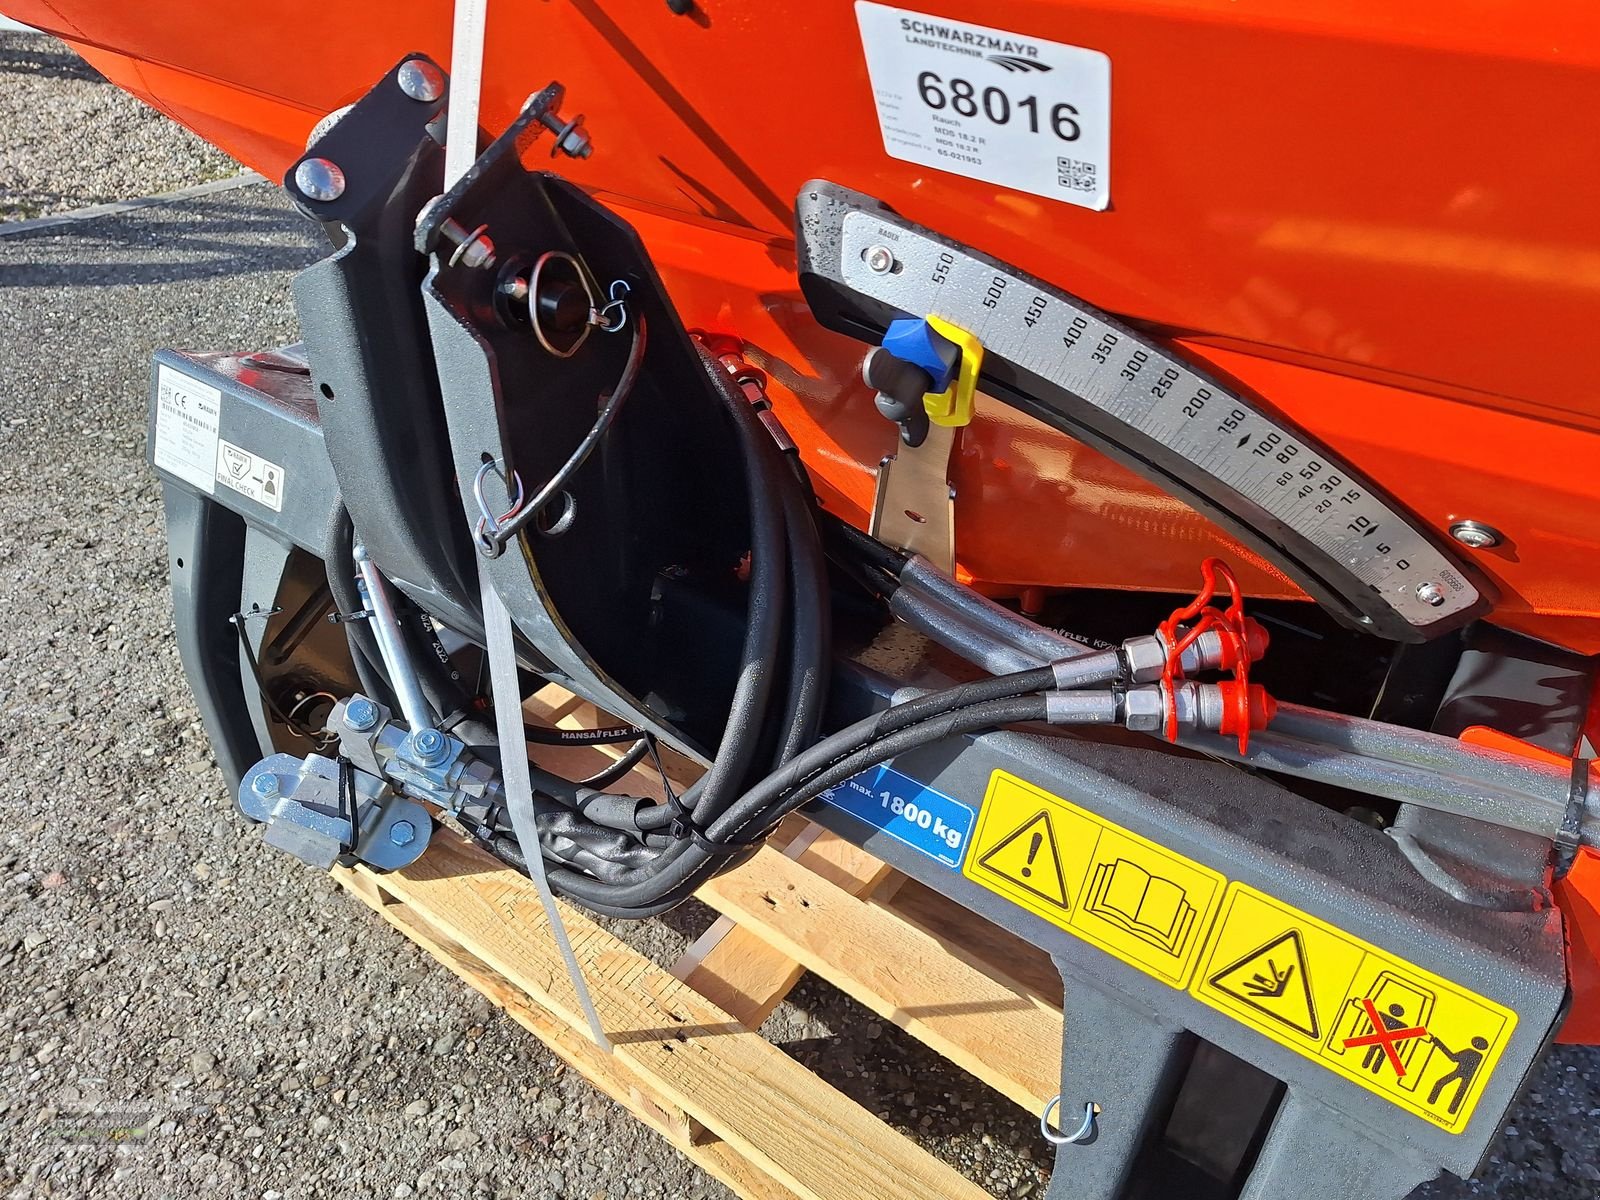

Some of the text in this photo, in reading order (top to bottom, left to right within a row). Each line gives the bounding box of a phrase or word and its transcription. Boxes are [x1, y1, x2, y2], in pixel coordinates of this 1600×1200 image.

[900, 18, 1039, 59] SCHWARZMAYR
[905, 35, 983, 58] LANDTECHNIK
[917, 71, 1080, 142] 68016
[932, 114, 961, 127] Rauch
[934, 126, 986, 145] MDS 18.2 R
[936, 137, 954, 148] MDS
[938, 147, 982, 165] 65-021953
[932, 252, 954, 285] 550
[982, 276, 1007, 309] 500
[1024, 296, 1048, 329] 450
[1062, 316, 1088, 349] 400
[1091, 332, 1118, 364] 350
[1120, 350, 1149, 382] 300
[1151, 368, 1180, 399] 250
[1182, 387, 1212, 419] 200
[1217, 409, 1246, 434] 150
[1252, 432, 1282, 458] 100
[1276, 444, 1299, 465] 80
[1276, 471, 1294, 486] 60
[1299, 460, 1322, 480] 50
[217, 472, 255, 498] FINAL CHECK
[1297, 485, 1314, 500] 40
[1320, 475, 1342, 494] 30
[1315, 498, 1332, 514] 20
[1340, 489, 1361, 505] 15
[1347, 515, 1370, 533] 10
[1376, 543, 1391, 555] 5
[1396, 559, 1410, 571] 0
[849, 781, 874, 798] max.
[880, 791, 962, 849] 1800 kg
